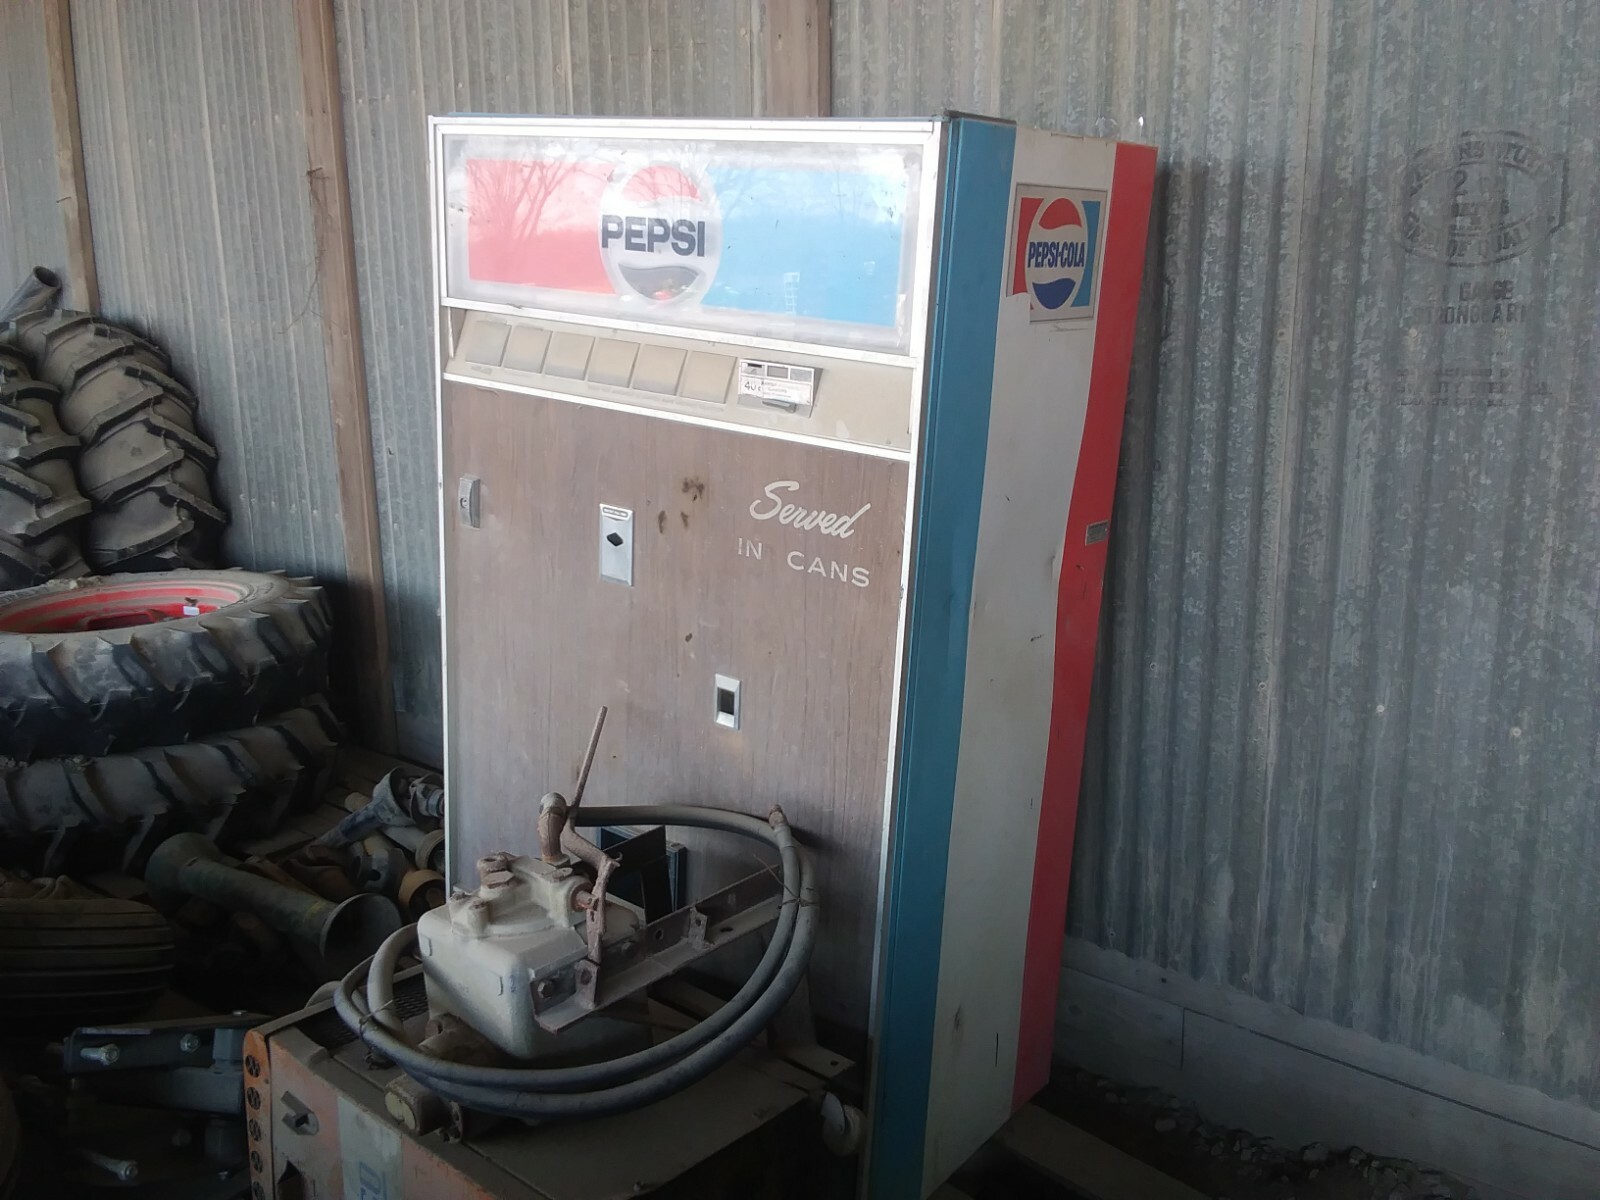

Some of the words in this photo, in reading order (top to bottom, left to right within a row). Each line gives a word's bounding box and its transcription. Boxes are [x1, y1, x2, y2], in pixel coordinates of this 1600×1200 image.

[601, 216, 705, 257] PEPSI
[749, 481, 871, 538] Served
[737, 538, 763, 560] IN
[786, 551, 870, 588] CANS
